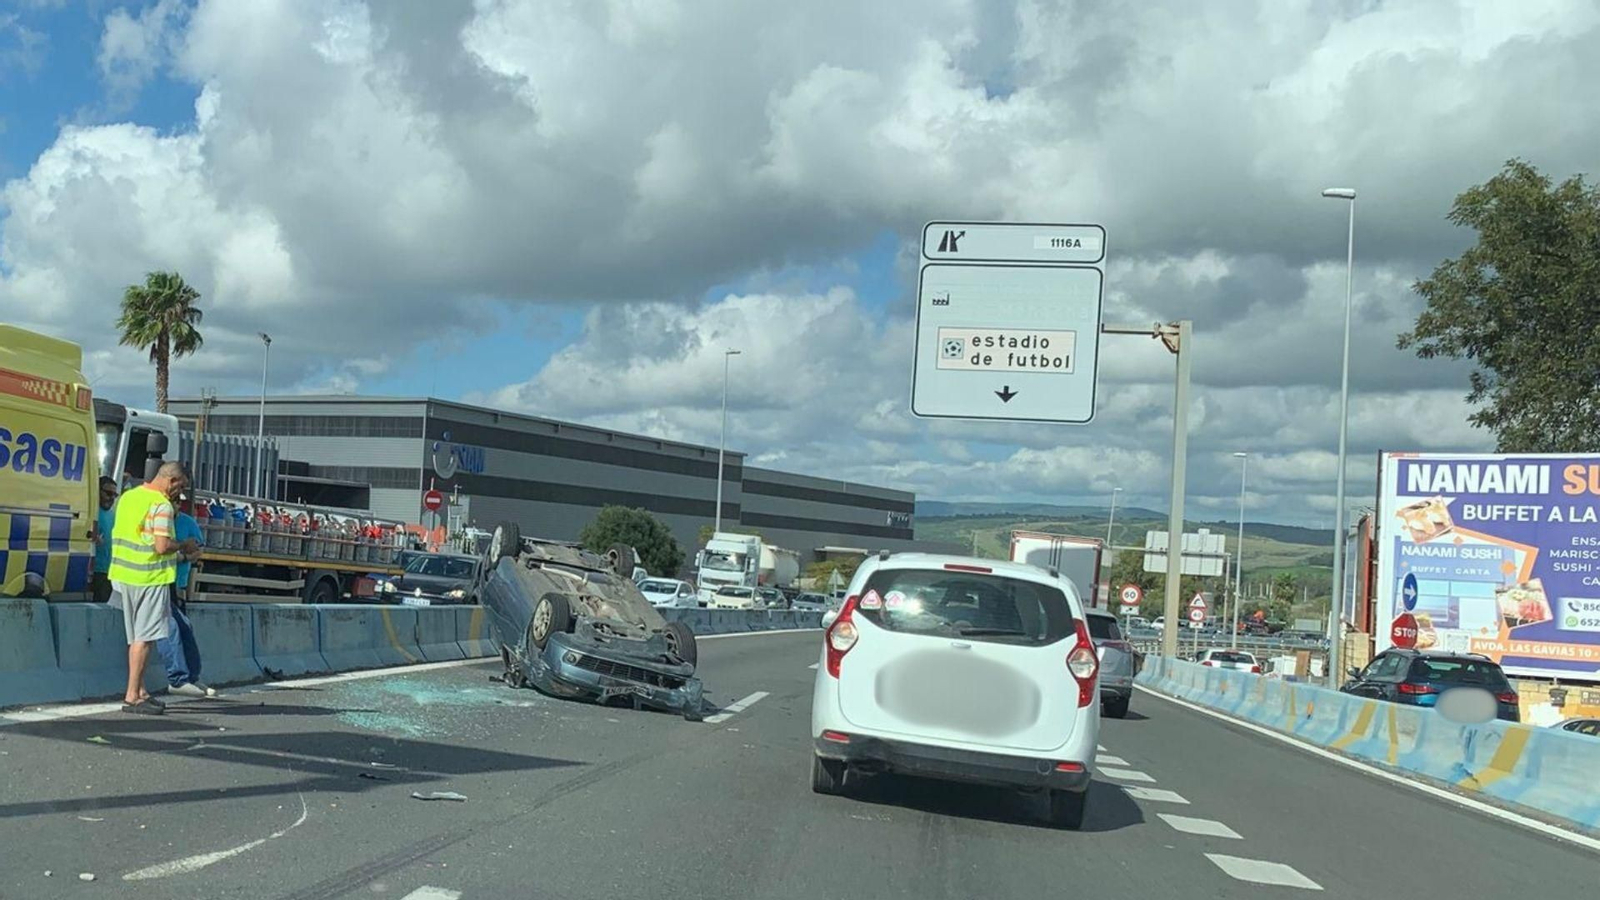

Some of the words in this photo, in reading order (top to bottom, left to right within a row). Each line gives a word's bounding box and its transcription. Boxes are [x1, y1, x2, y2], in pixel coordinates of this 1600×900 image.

[1050, 238, 1082, 248] 1116A
[971, 334, 1050, 349] estadio
[970, 352, 993, 366] de
[1007, 352, 1070, 369] futbol
[1407, 463, 1551, 495] NANAMI
[1462, 504, 1544, 521] BUFFET
[1547, 506, 1564, 522] A
[1569, 506, 1598, 523] LA
[1401, 545, 1457, 558] NANAMI
[1460, 547, 1502, 560] SUSHI
[1411, 566, 1447, 574] BUFFET
[1455, 567, 1490, 576] CARTA
[1553, 562, 1592, 572] SUSHI
[1393, 627, 1417, 638] STOP
[1474, 641, 1508, 652] AVDA.
[1509, 643, 1531, 654] LAS
[1532, 644, 1576, 656] GAVIAS
[1578, 648, 1592, 657] 10
